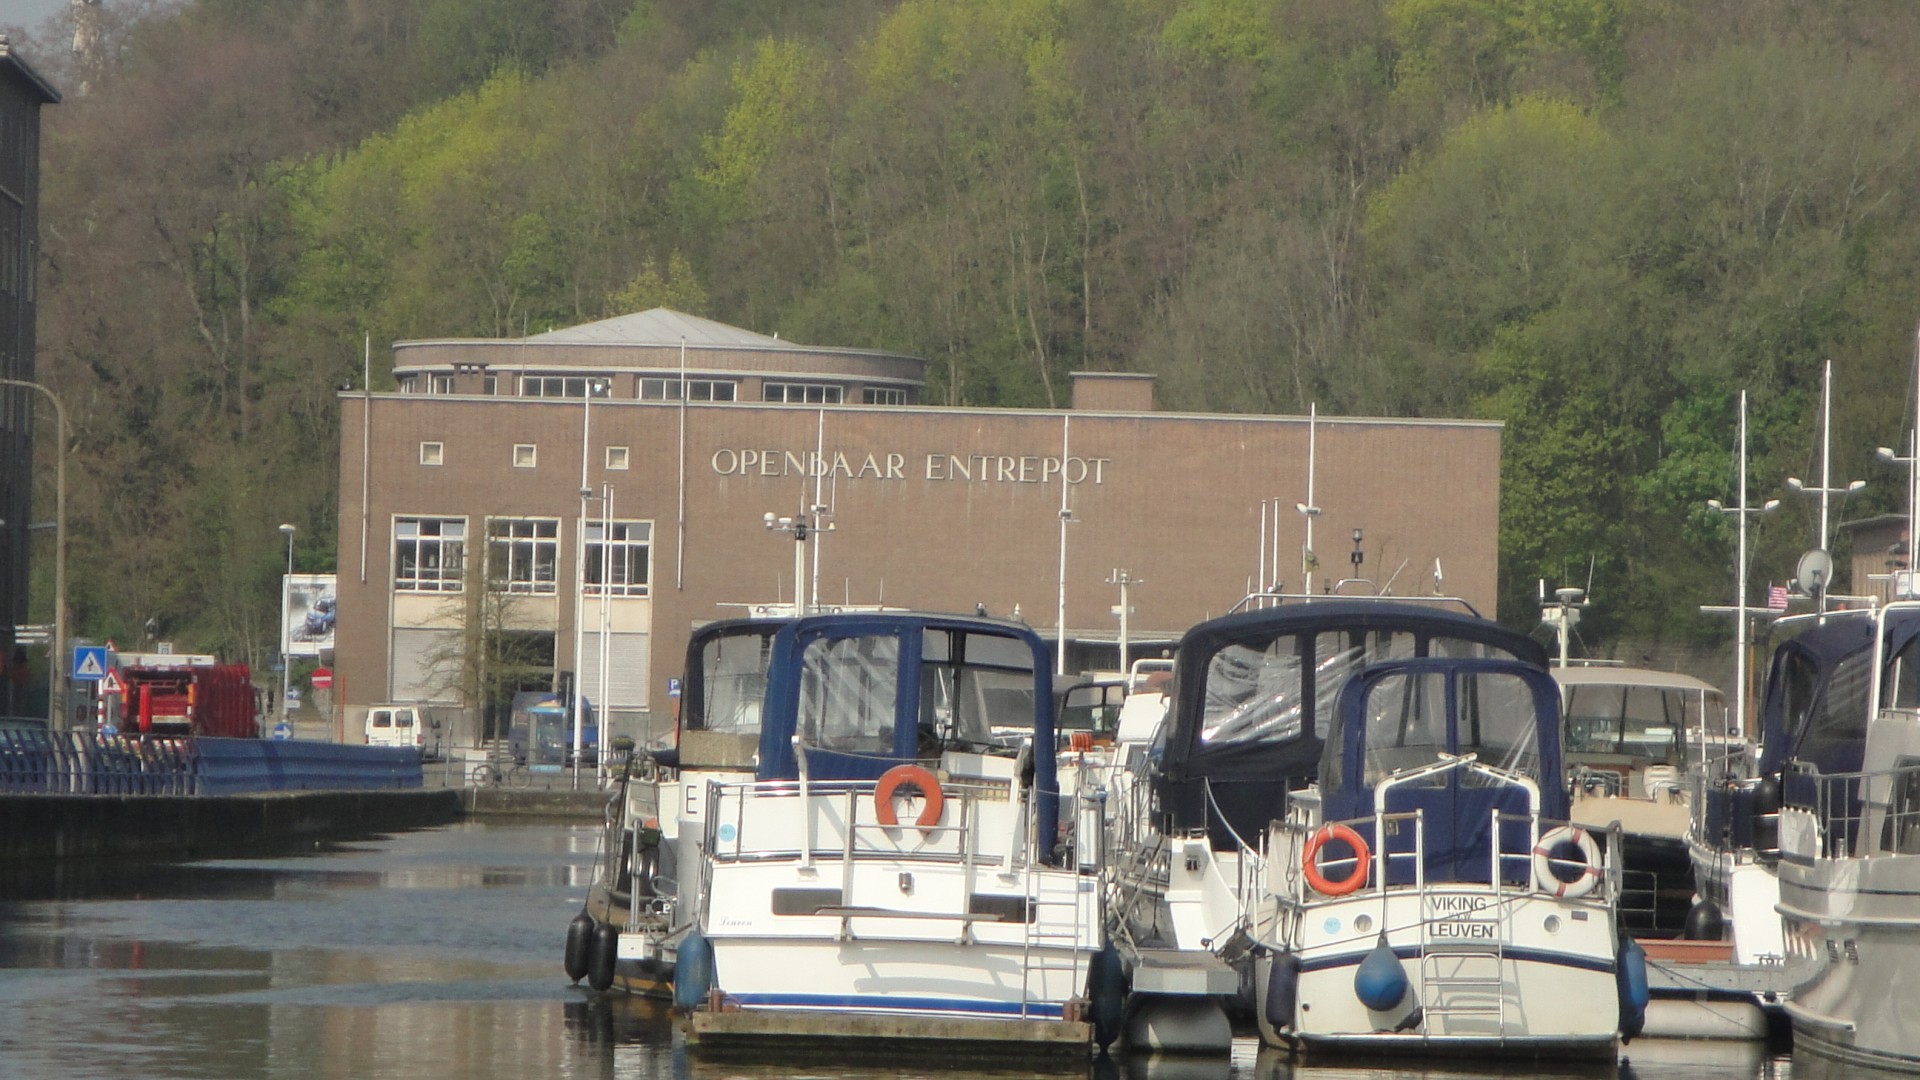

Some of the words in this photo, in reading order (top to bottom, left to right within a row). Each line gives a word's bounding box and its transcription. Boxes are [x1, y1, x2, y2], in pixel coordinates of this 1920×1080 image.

[711, 448, 906, 479] OPENBAAR
[925, 453, 1112, 484] ENTREPOT
[670, 679, 680, 690] P
[686, 784, 698, 815] E
[1431, 896, 1487, 911] VIKING
[1429, 923, 1494, 938] LEUVEN
